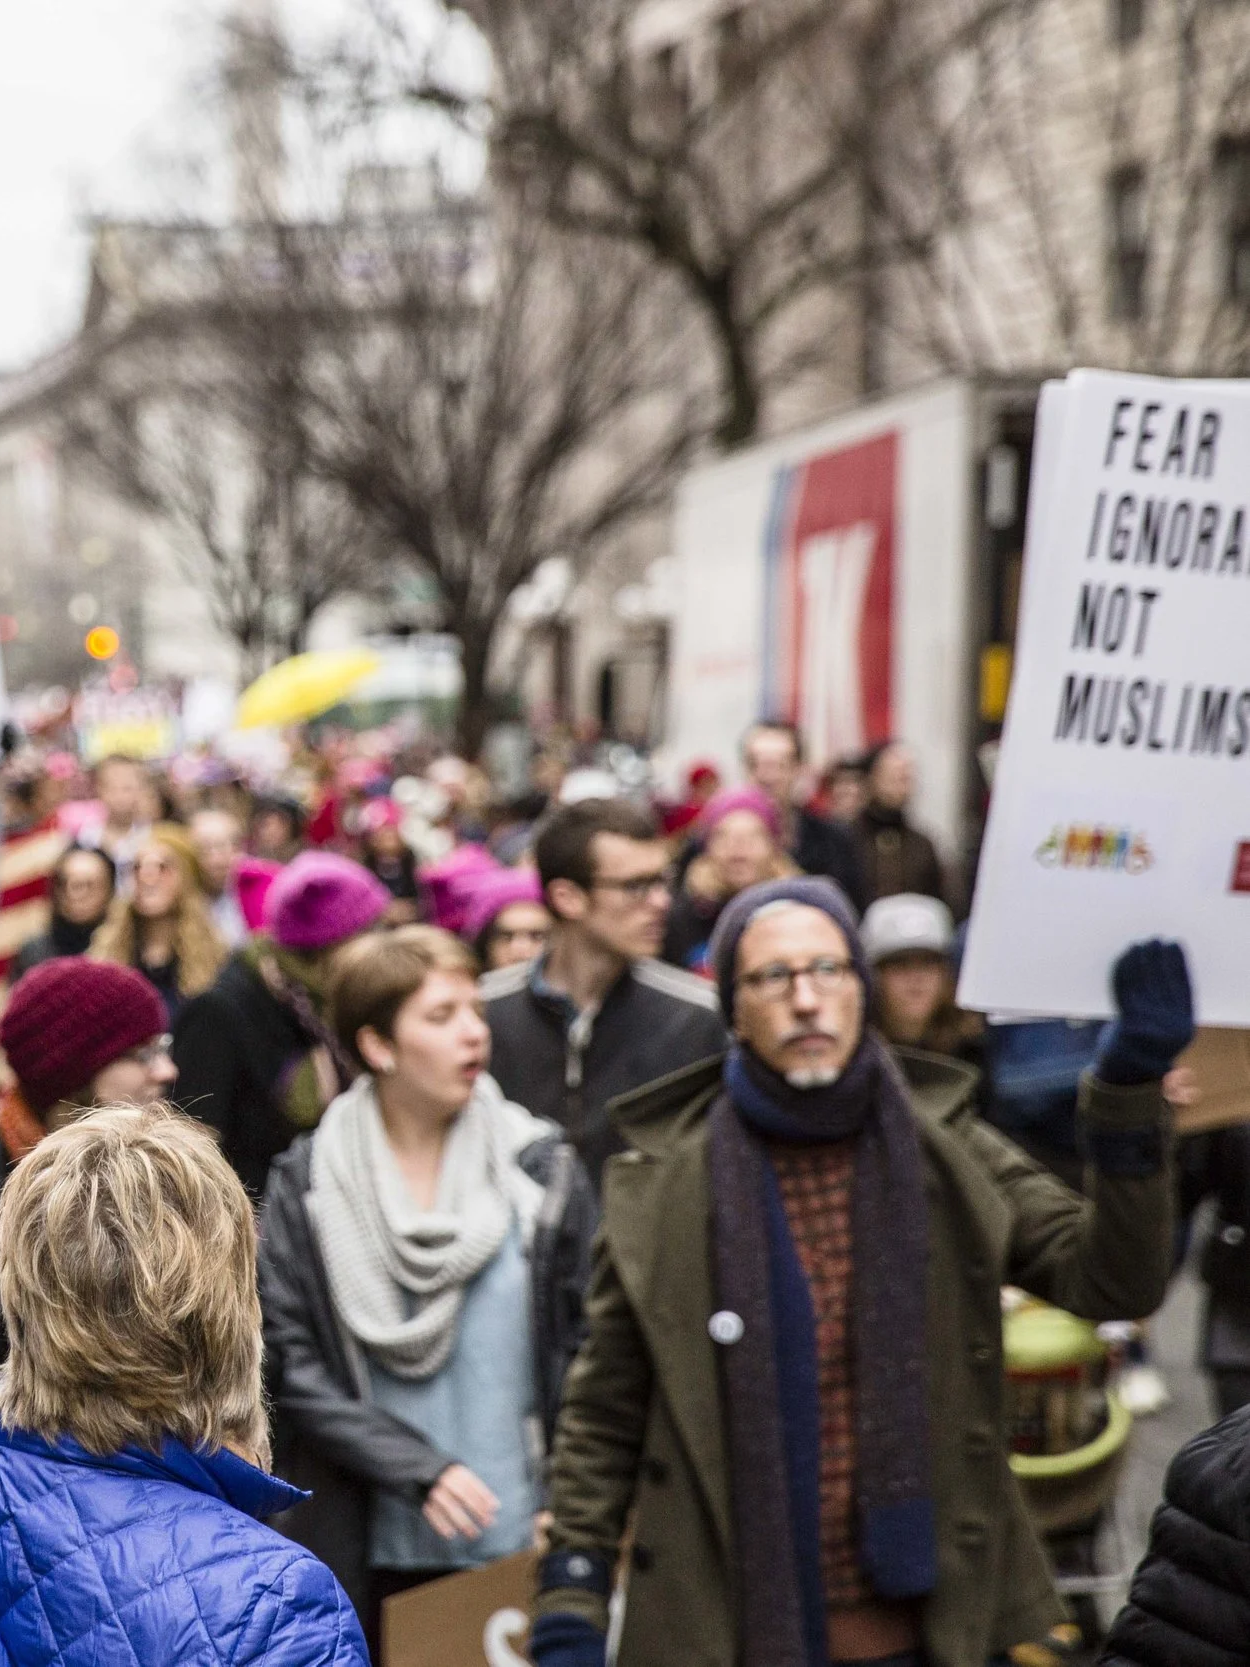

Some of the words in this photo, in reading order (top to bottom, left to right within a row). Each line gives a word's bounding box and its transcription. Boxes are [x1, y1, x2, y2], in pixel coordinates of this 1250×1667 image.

[1103, 397, 1223, 479] FEAR
[1085, 490, 1250, 577] IGNORA
[1070, 582, 1161, 658] NOT
[1053, 671, 1250, 761] MUSLIMS
